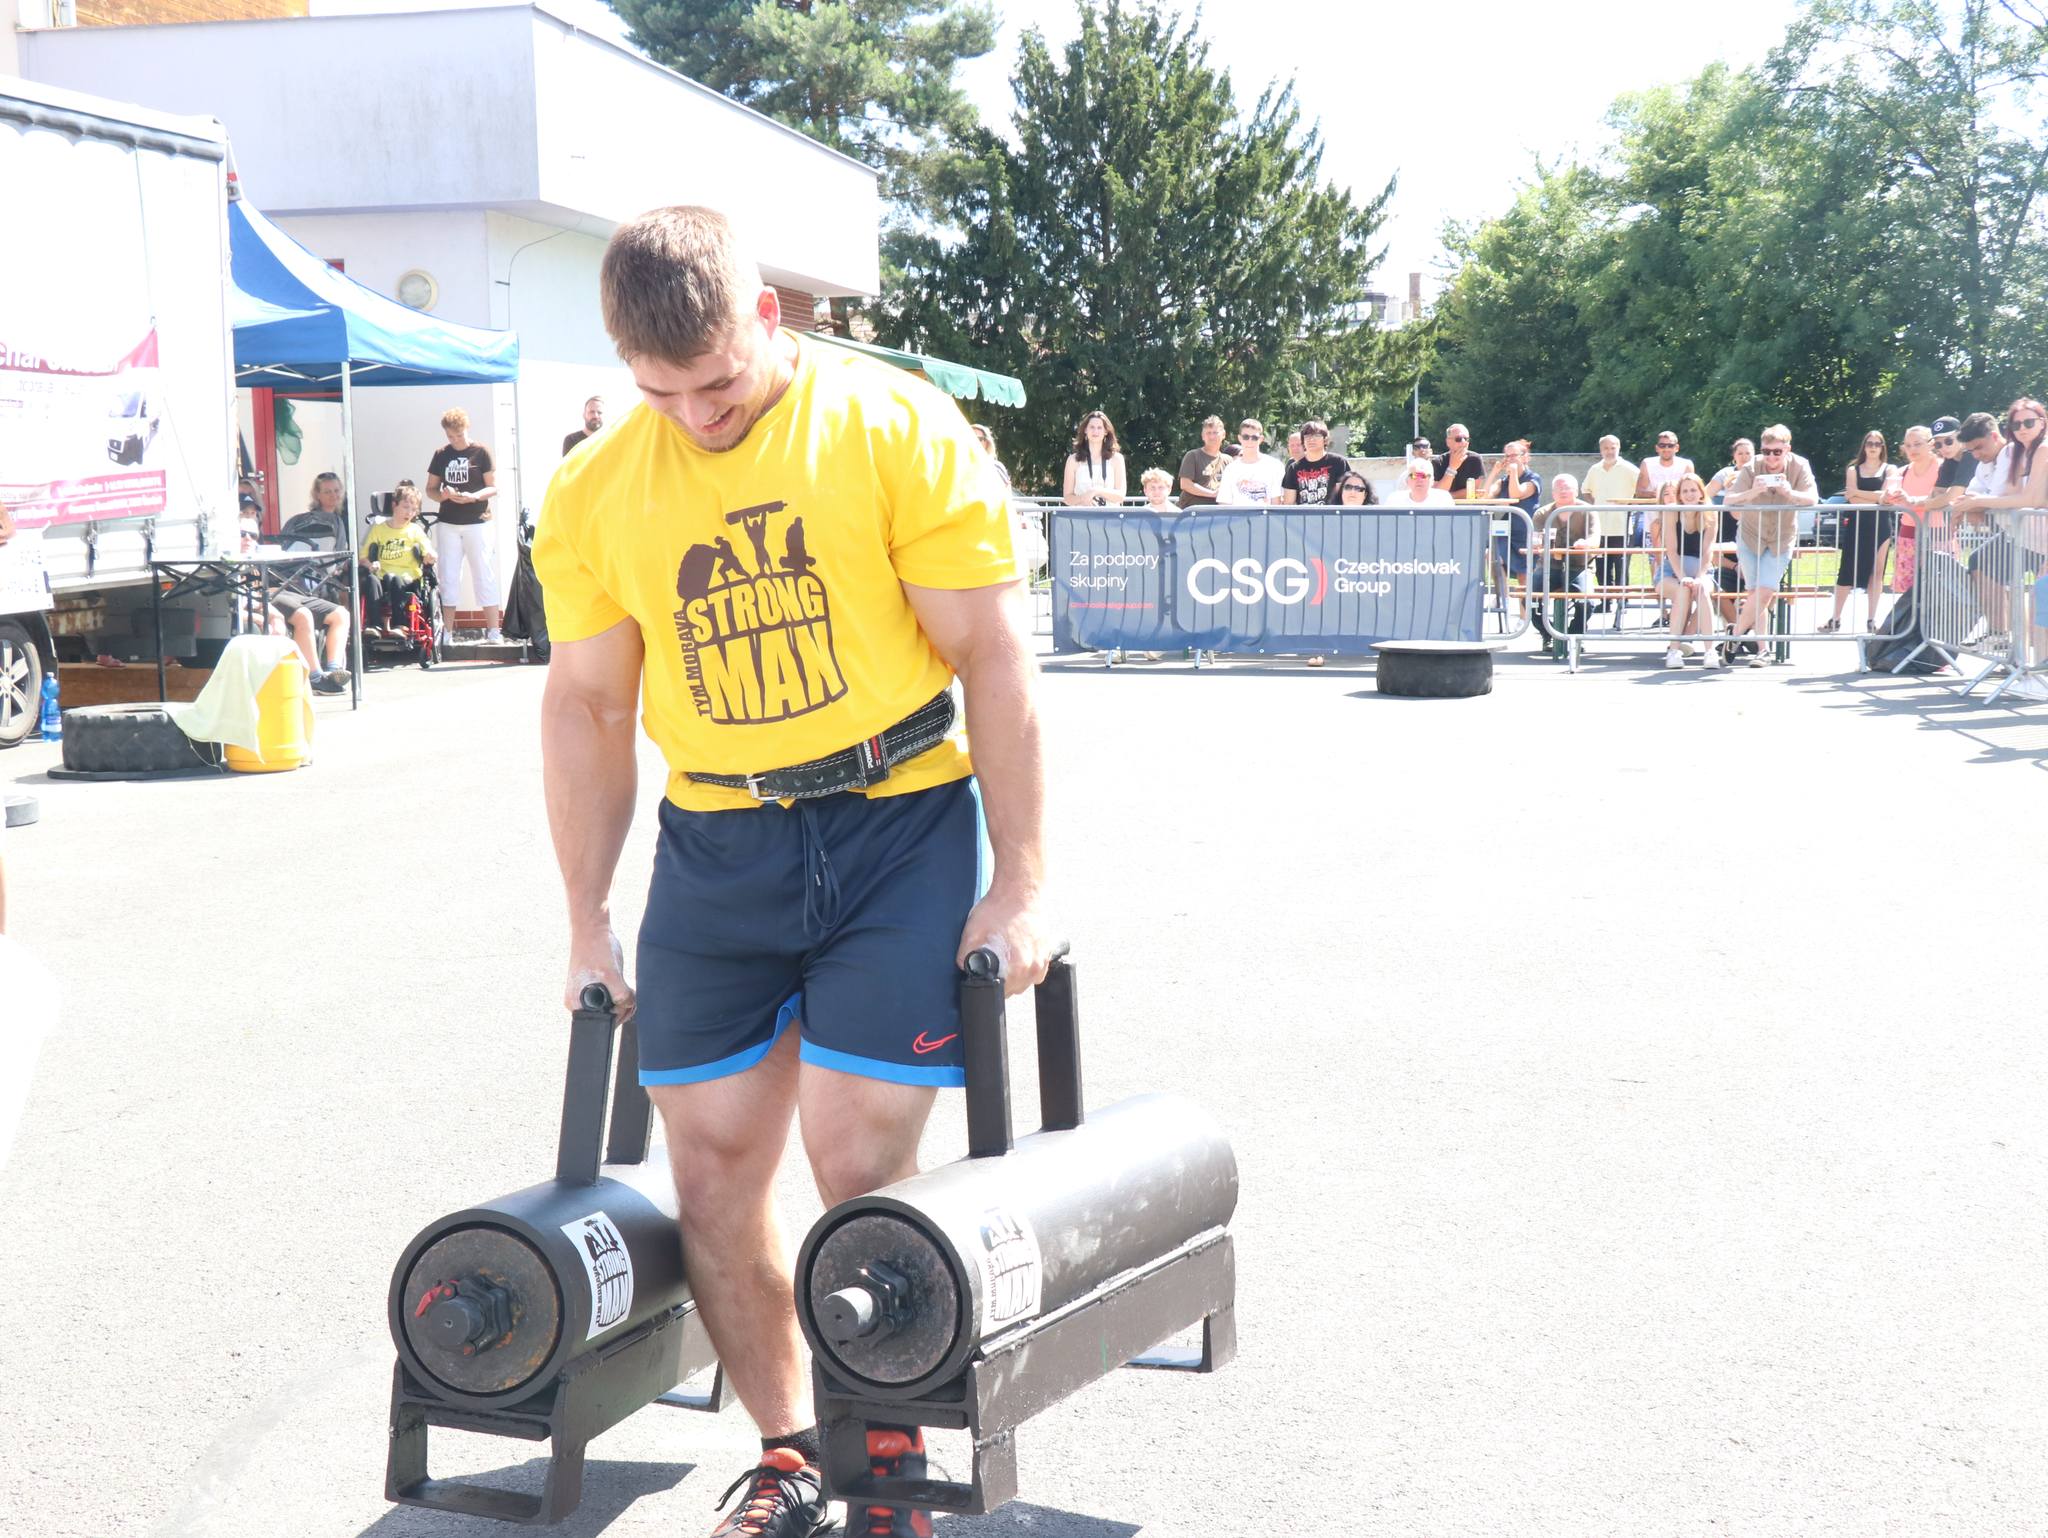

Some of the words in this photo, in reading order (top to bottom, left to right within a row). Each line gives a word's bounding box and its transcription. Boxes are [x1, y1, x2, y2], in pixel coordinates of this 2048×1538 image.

[448, 471, 468, 482] MAN
[1069, 551, 1089, 566] Za
[1093, 551, 1160, 570] podpory
[1333, 558, 1461, 575] Czechoslovak
[1069, 573, 1129, 591] skupiny
[1186, 557, 1310, 605] CSG
[1333, 577, 1392, 597] Group
[685, 574, 827, 644] STRONG
[672, 610, 701, 682] MORAVA
[696, 619, 846, 721] MAN
[863, 739, 875, 769] POWER
[594, 1250, 628, 1284] STRONG
[599, 1272, 630, 1326] MAN
